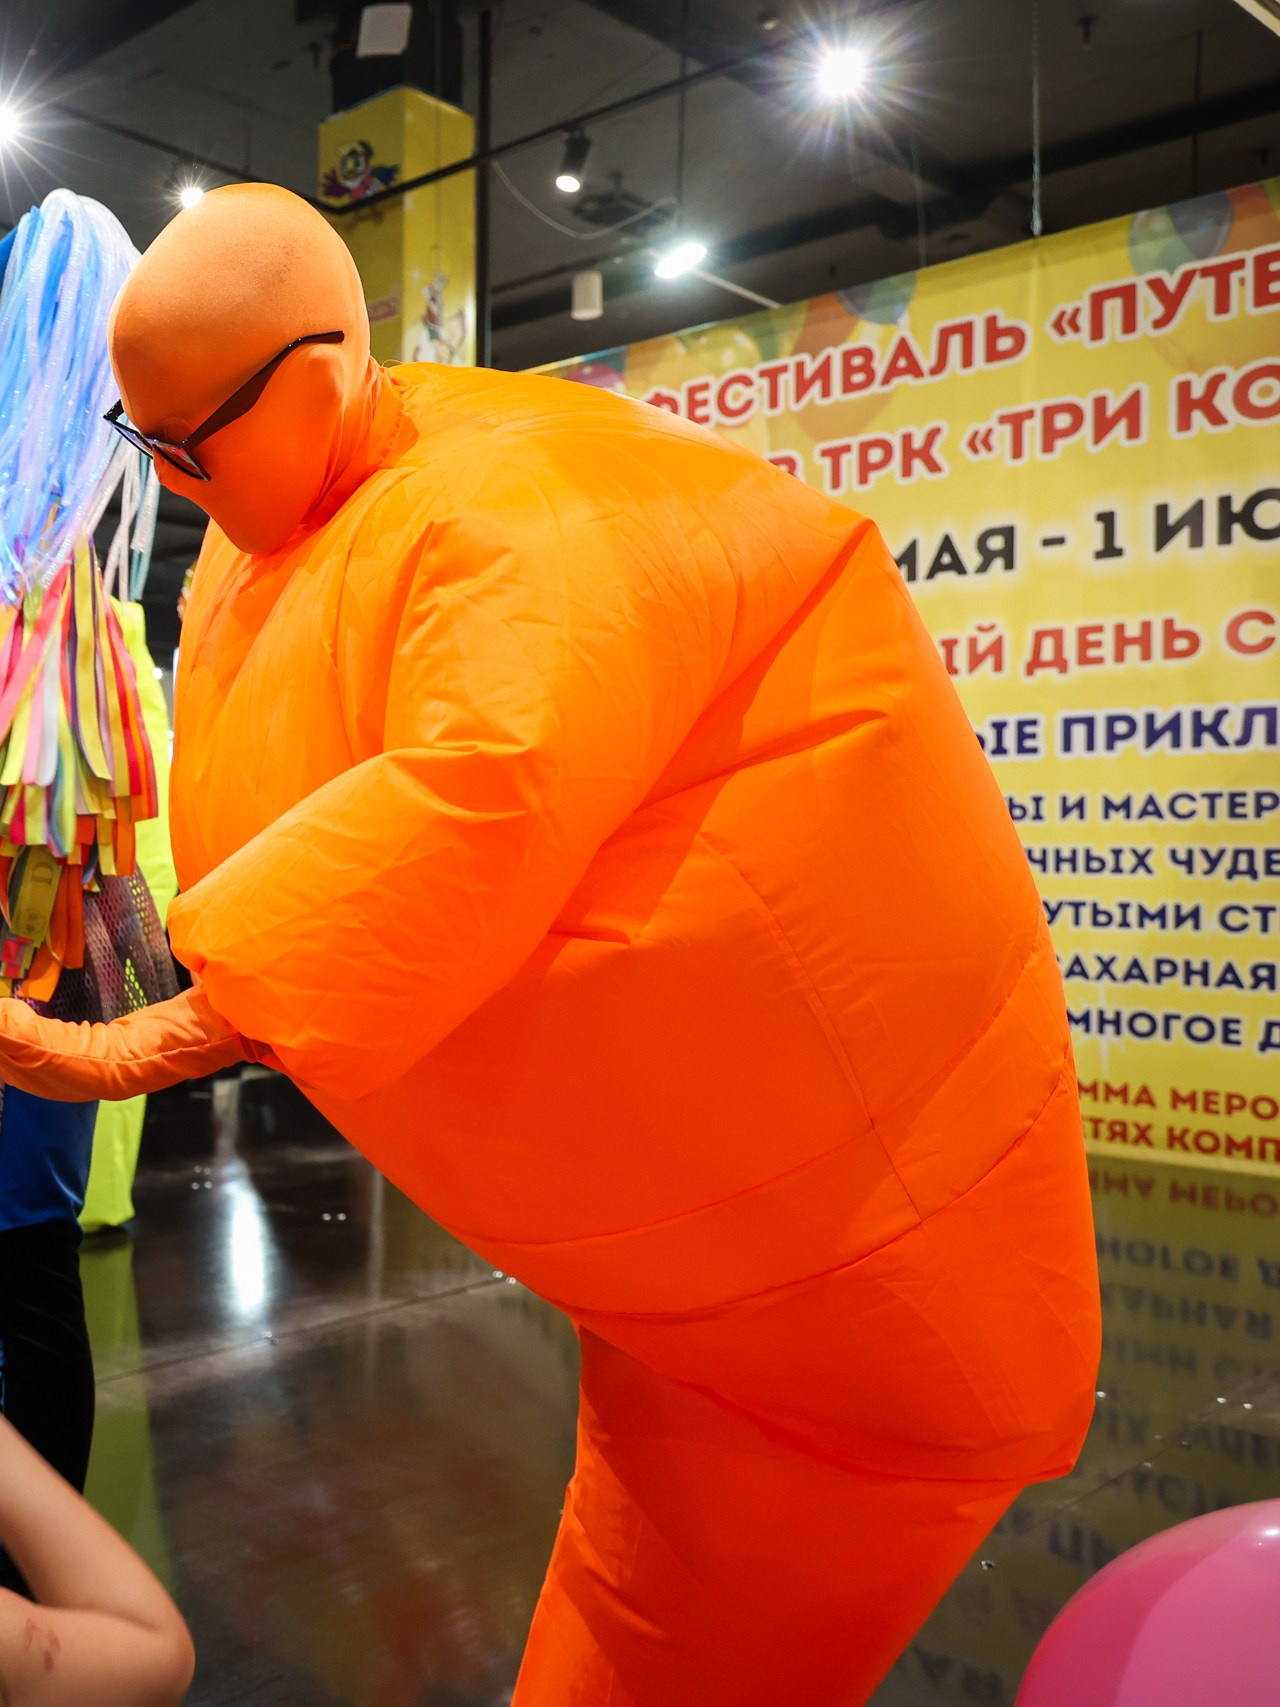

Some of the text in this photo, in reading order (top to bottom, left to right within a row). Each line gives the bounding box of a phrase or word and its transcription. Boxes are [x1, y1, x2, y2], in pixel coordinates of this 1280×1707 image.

[1052, 248, 1280, 341] «ПУТЕ
[821, 364, 1280, 490] ТРК «ТРИ КО
[1095, 511, 1123, 559] 1
[1155, 488, 1280, 552] ИЮ
[1026, 617, 1200, 677] ДЕНЬ
[1226, 609, 1276, 655] С
[1063, 706, 1277, 753] ПРИКЛ
[1061, 795, 1085, 820] И
[1103, 791, 1280, 820] МАСТЕР
[1170, 848, 1280, 881] ЧУДЕ
[1042, 901, 1200, 931] УТЫМИ
[1056, 954, 1276, 991] АХАРНАЯ
[1066, 1009, 1242, 1046] МНОГОЕ
[1170, 1086, 1280, 1121] МЕРО
[1083, 1115, 1280, 1164] ТЯХ КОМП
